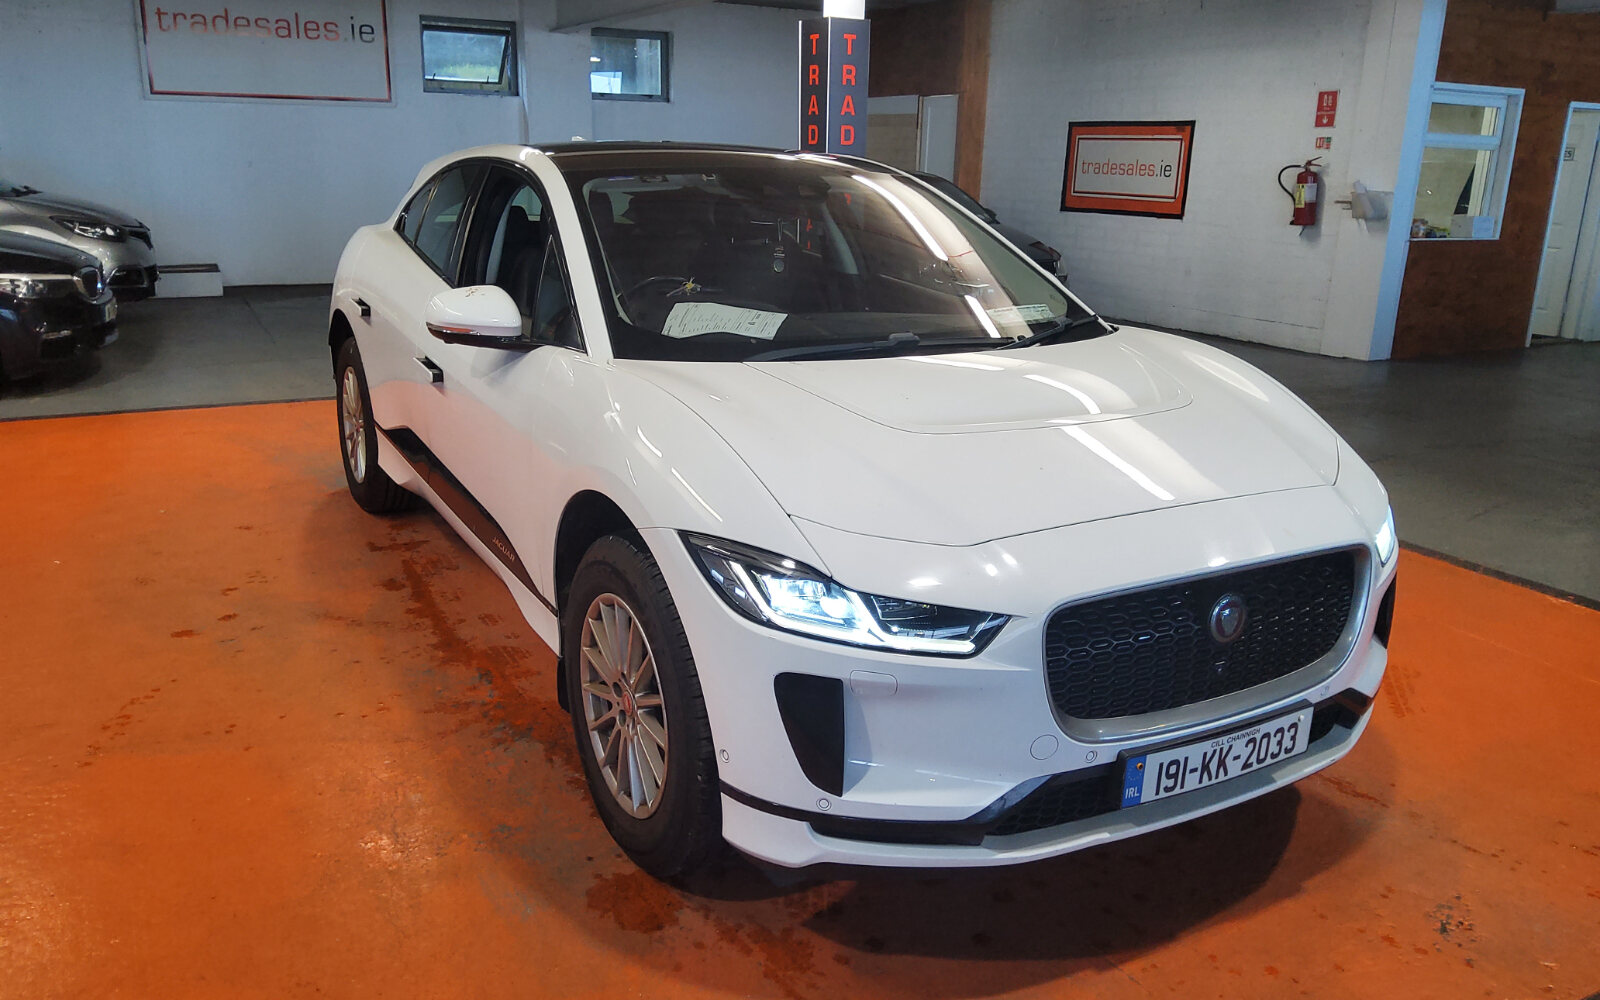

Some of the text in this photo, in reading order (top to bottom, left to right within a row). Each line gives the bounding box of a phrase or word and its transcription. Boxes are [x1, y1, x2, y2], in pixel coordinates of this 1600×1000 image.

[154, 7, 376, 44] tradesales.ie
[808, 33, 820, 145] TRAD
[840, 33, 857, 146] TRAD
[1081, 157, 1173, 178] tradesales.ie
[1154, 722, 1299, 796] 191-KK-2033
[1125, 787, 1140, 799] IRL
